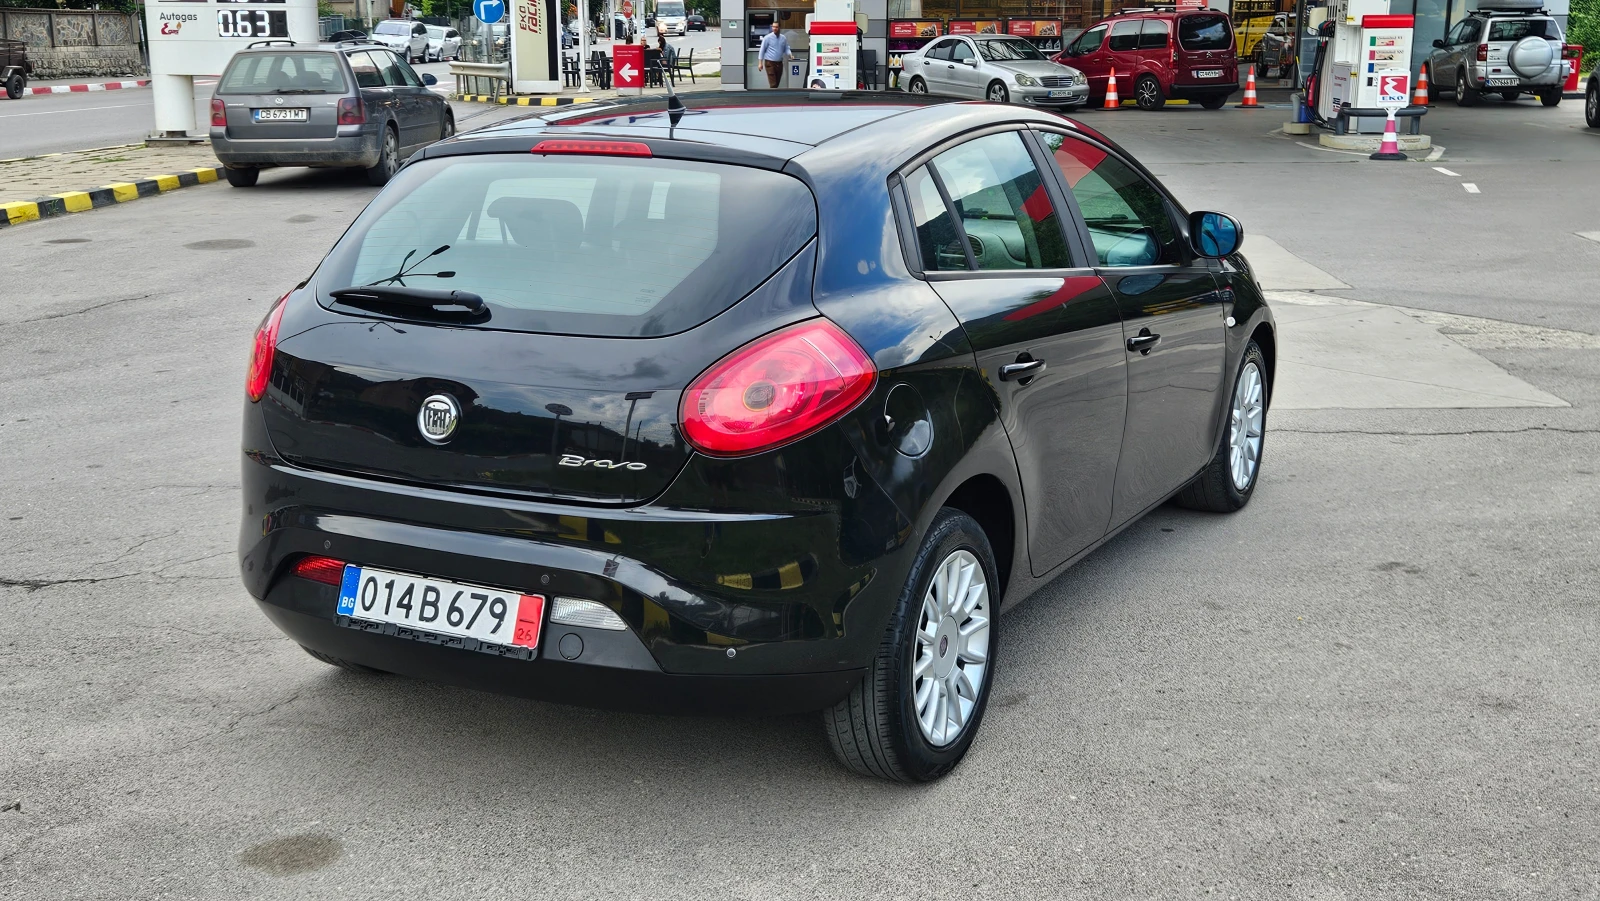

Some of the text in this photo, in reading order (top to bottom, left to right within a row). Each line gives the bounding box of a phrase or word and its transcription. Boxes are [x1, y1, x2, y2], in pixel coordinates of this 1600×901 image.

[159, 12, 198, 23] Autogas
[218, 9, 271, 37] 0.63
[558, 454, 647, 470] Bravo
[341, 596, 355, 608] BG
[516, 628, 532, 642] 26
